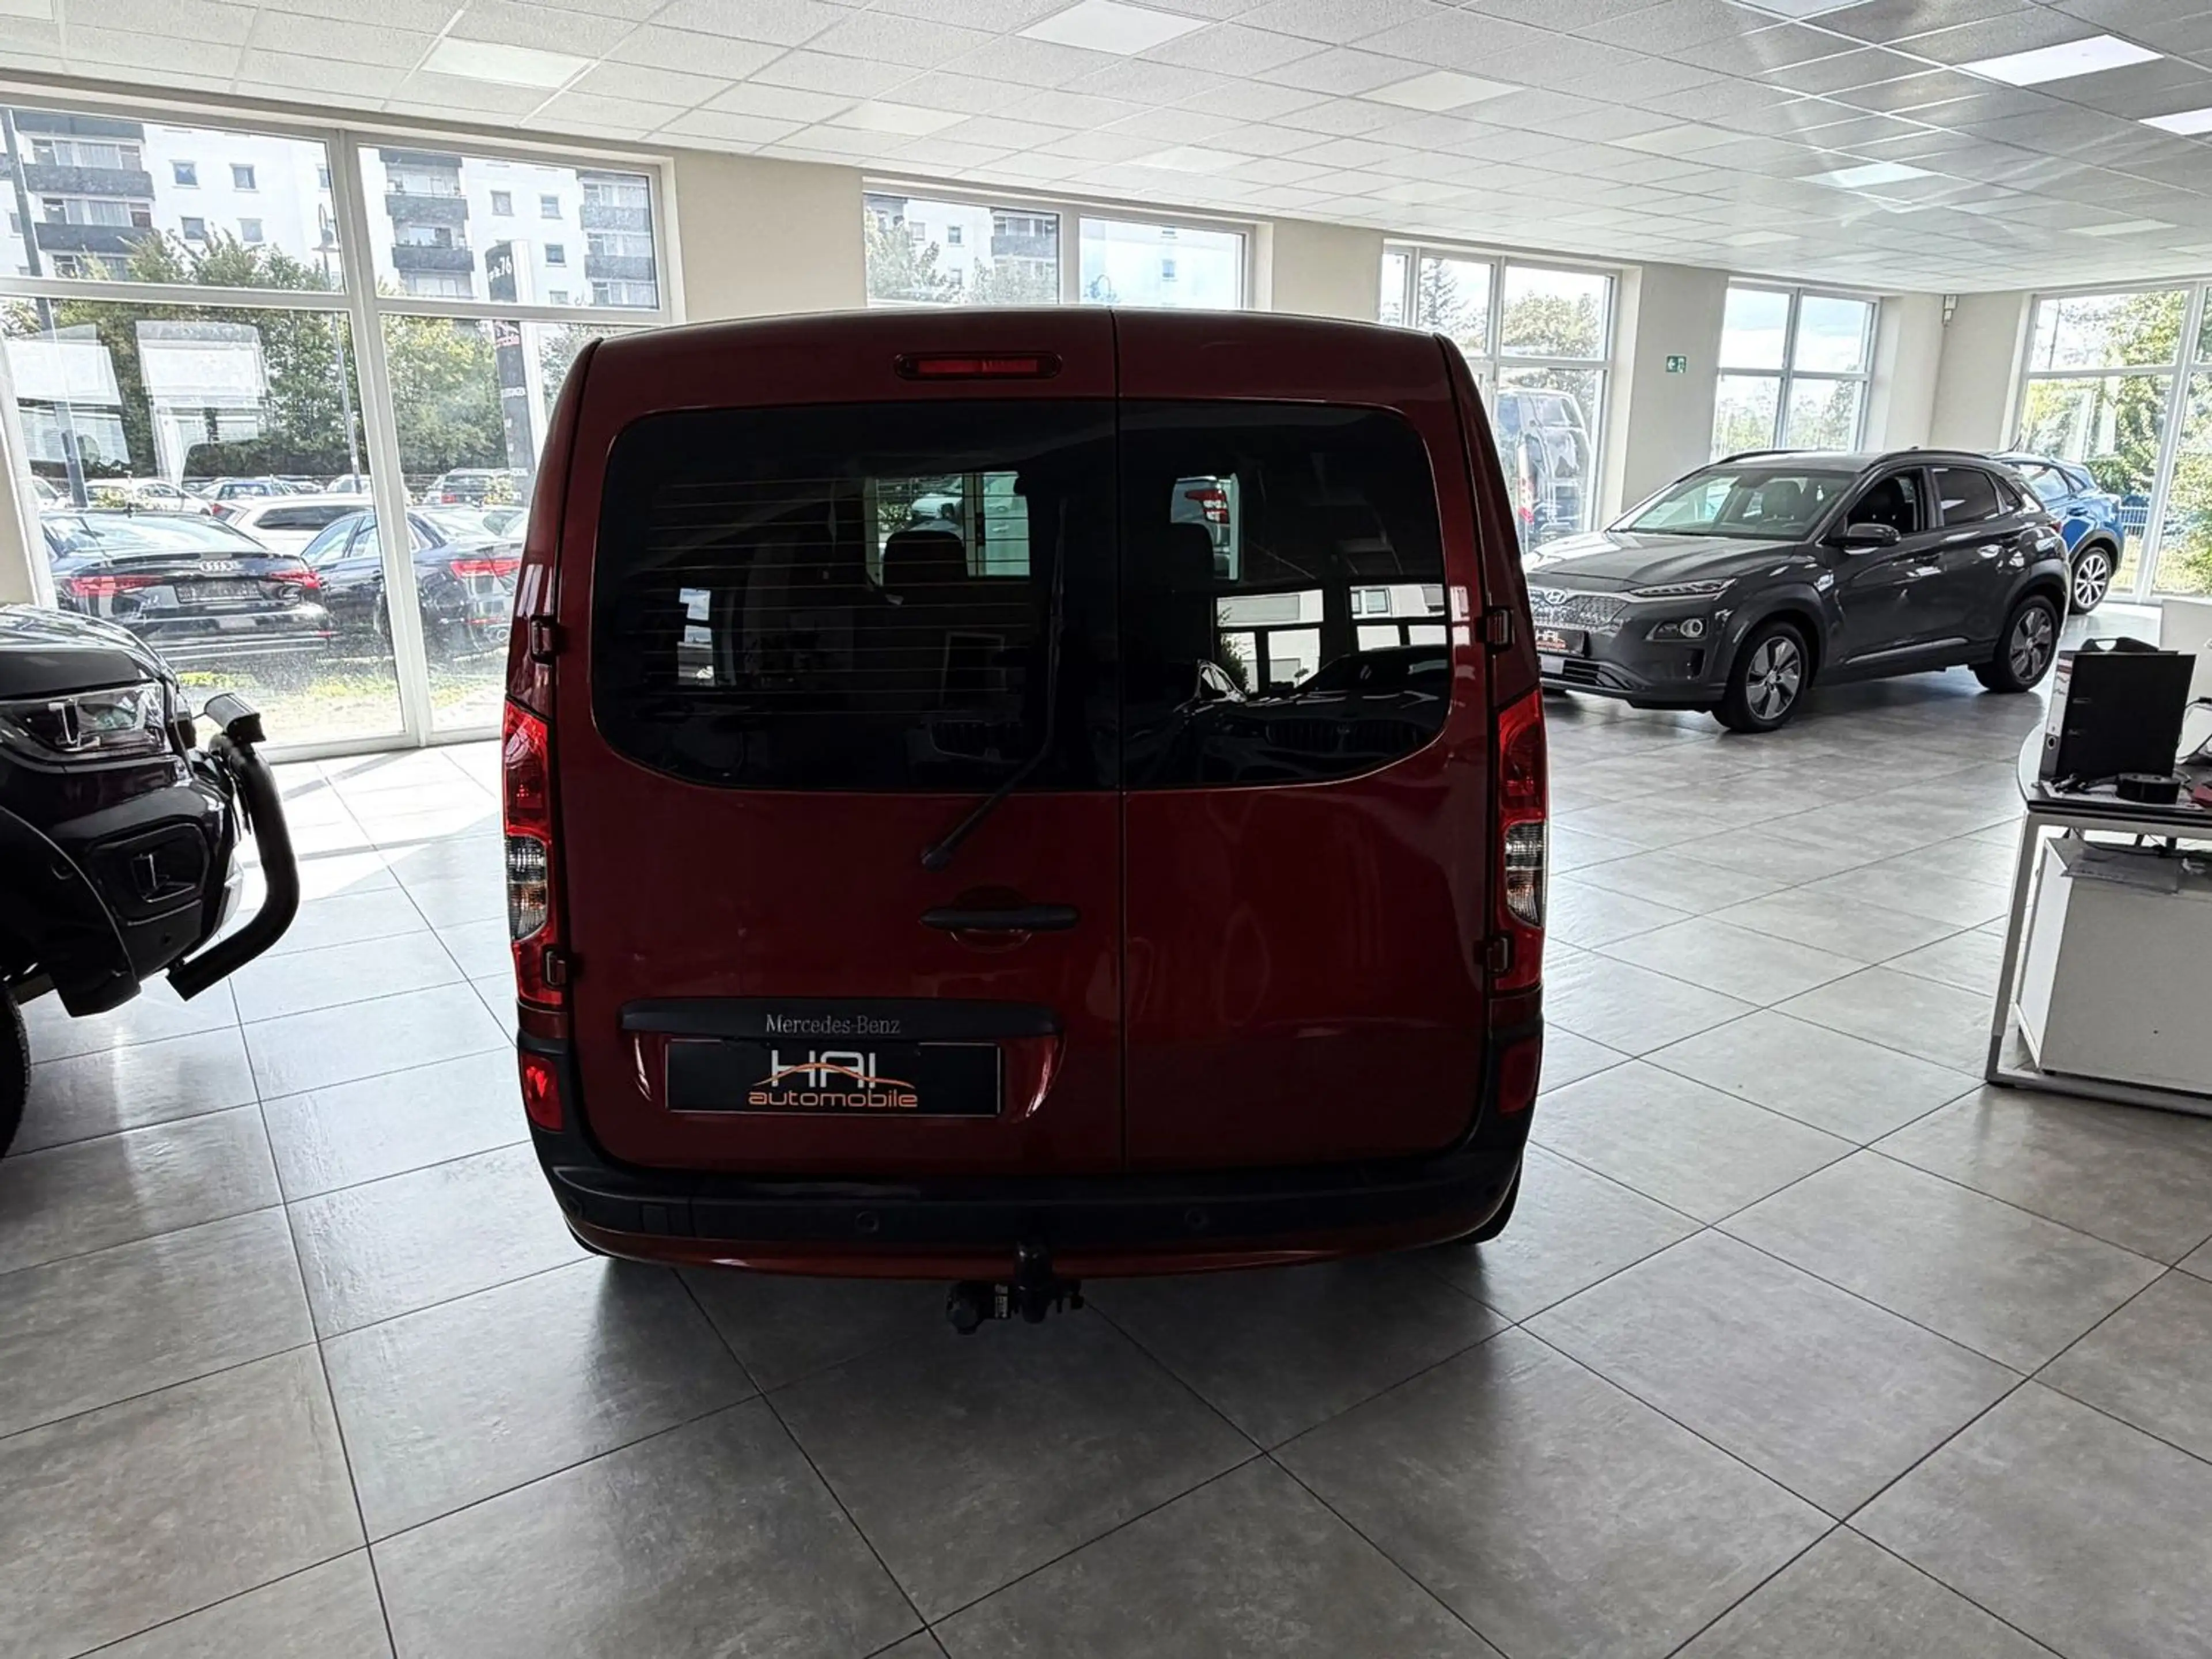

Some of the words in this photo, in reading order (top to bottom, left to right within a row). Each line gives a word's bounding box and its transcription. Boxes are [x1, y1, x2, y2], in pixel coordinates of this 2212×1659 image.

[766, 1014, 901, 1035] Mercedes-Benz
[771, 1049, 876, 1089] HAI
[748, 1089, 918, 1108] automobile
